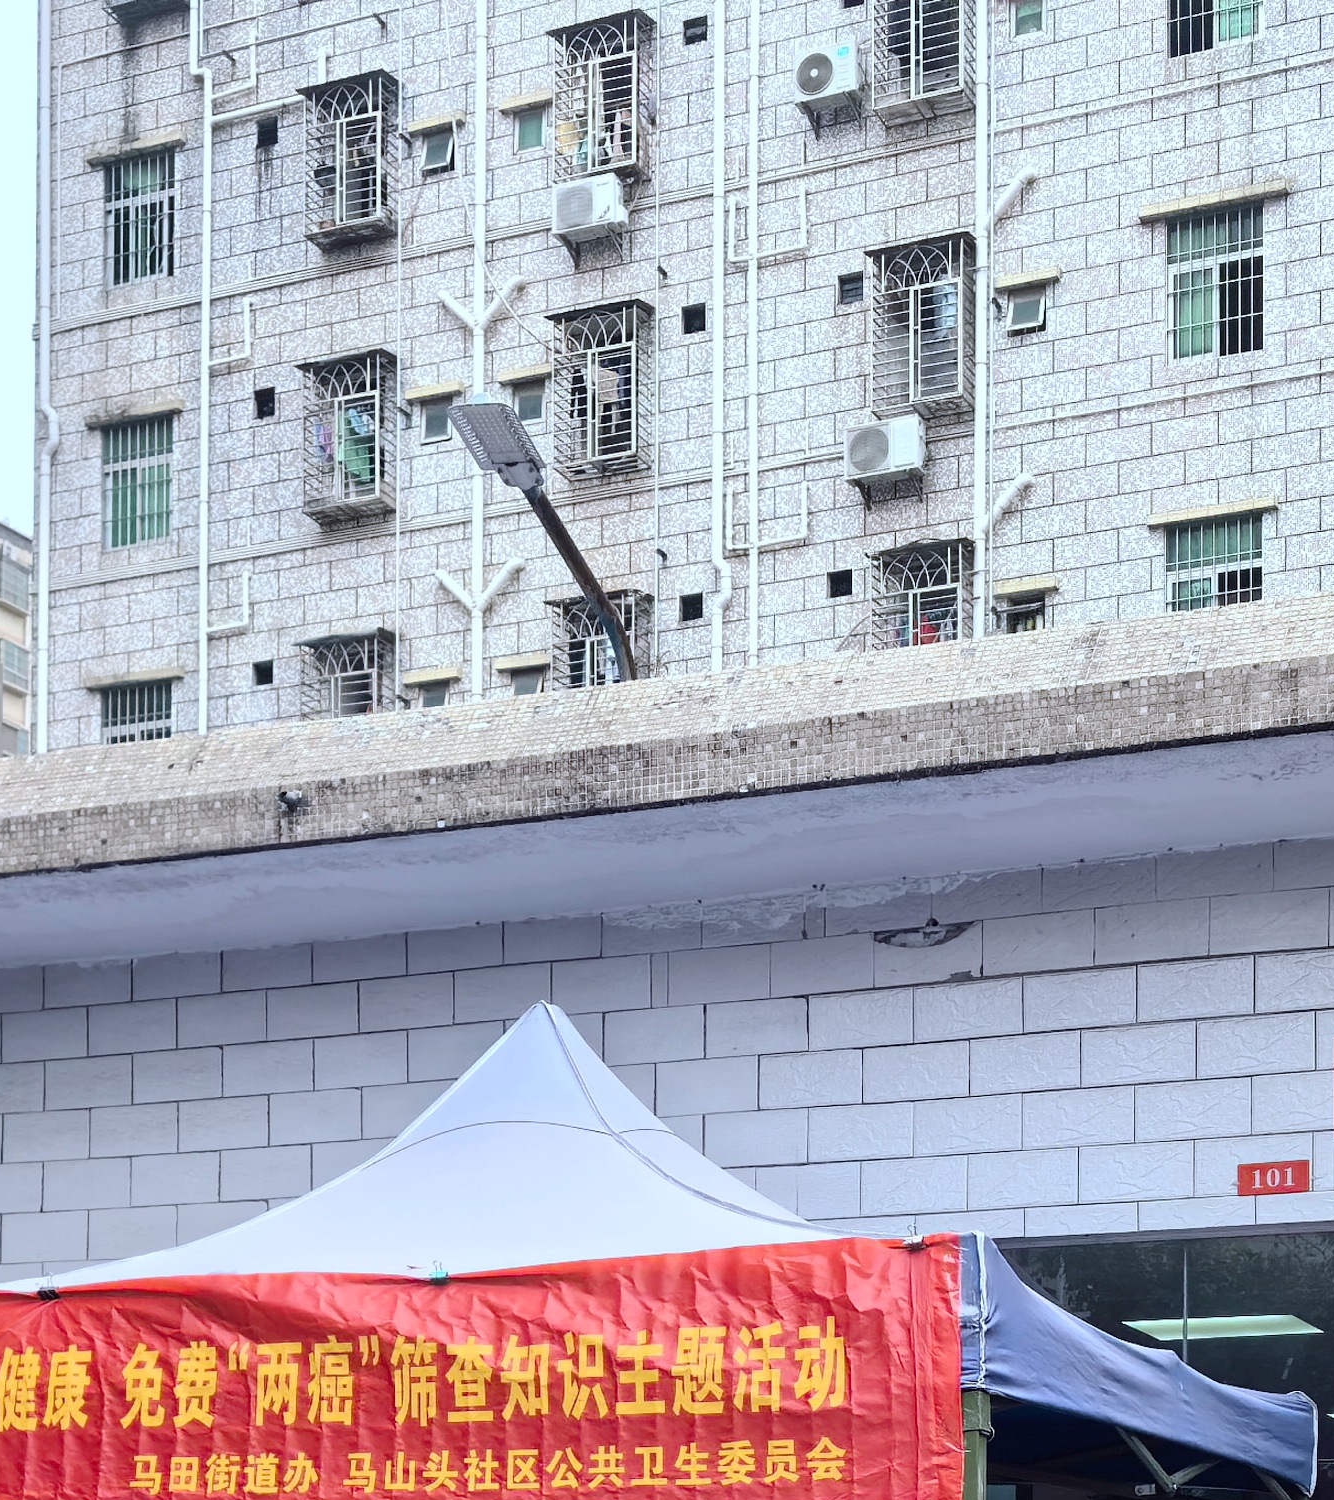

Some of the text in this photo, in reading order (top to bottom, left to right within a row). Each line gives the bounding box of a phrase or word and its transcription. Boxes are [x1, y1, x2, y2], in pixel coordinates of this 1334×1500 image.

[1250, 1166, 1294, 1189] 101
[129, 1437, 847, 1495] 马田街道办 马山头社区公共卫生委员会
